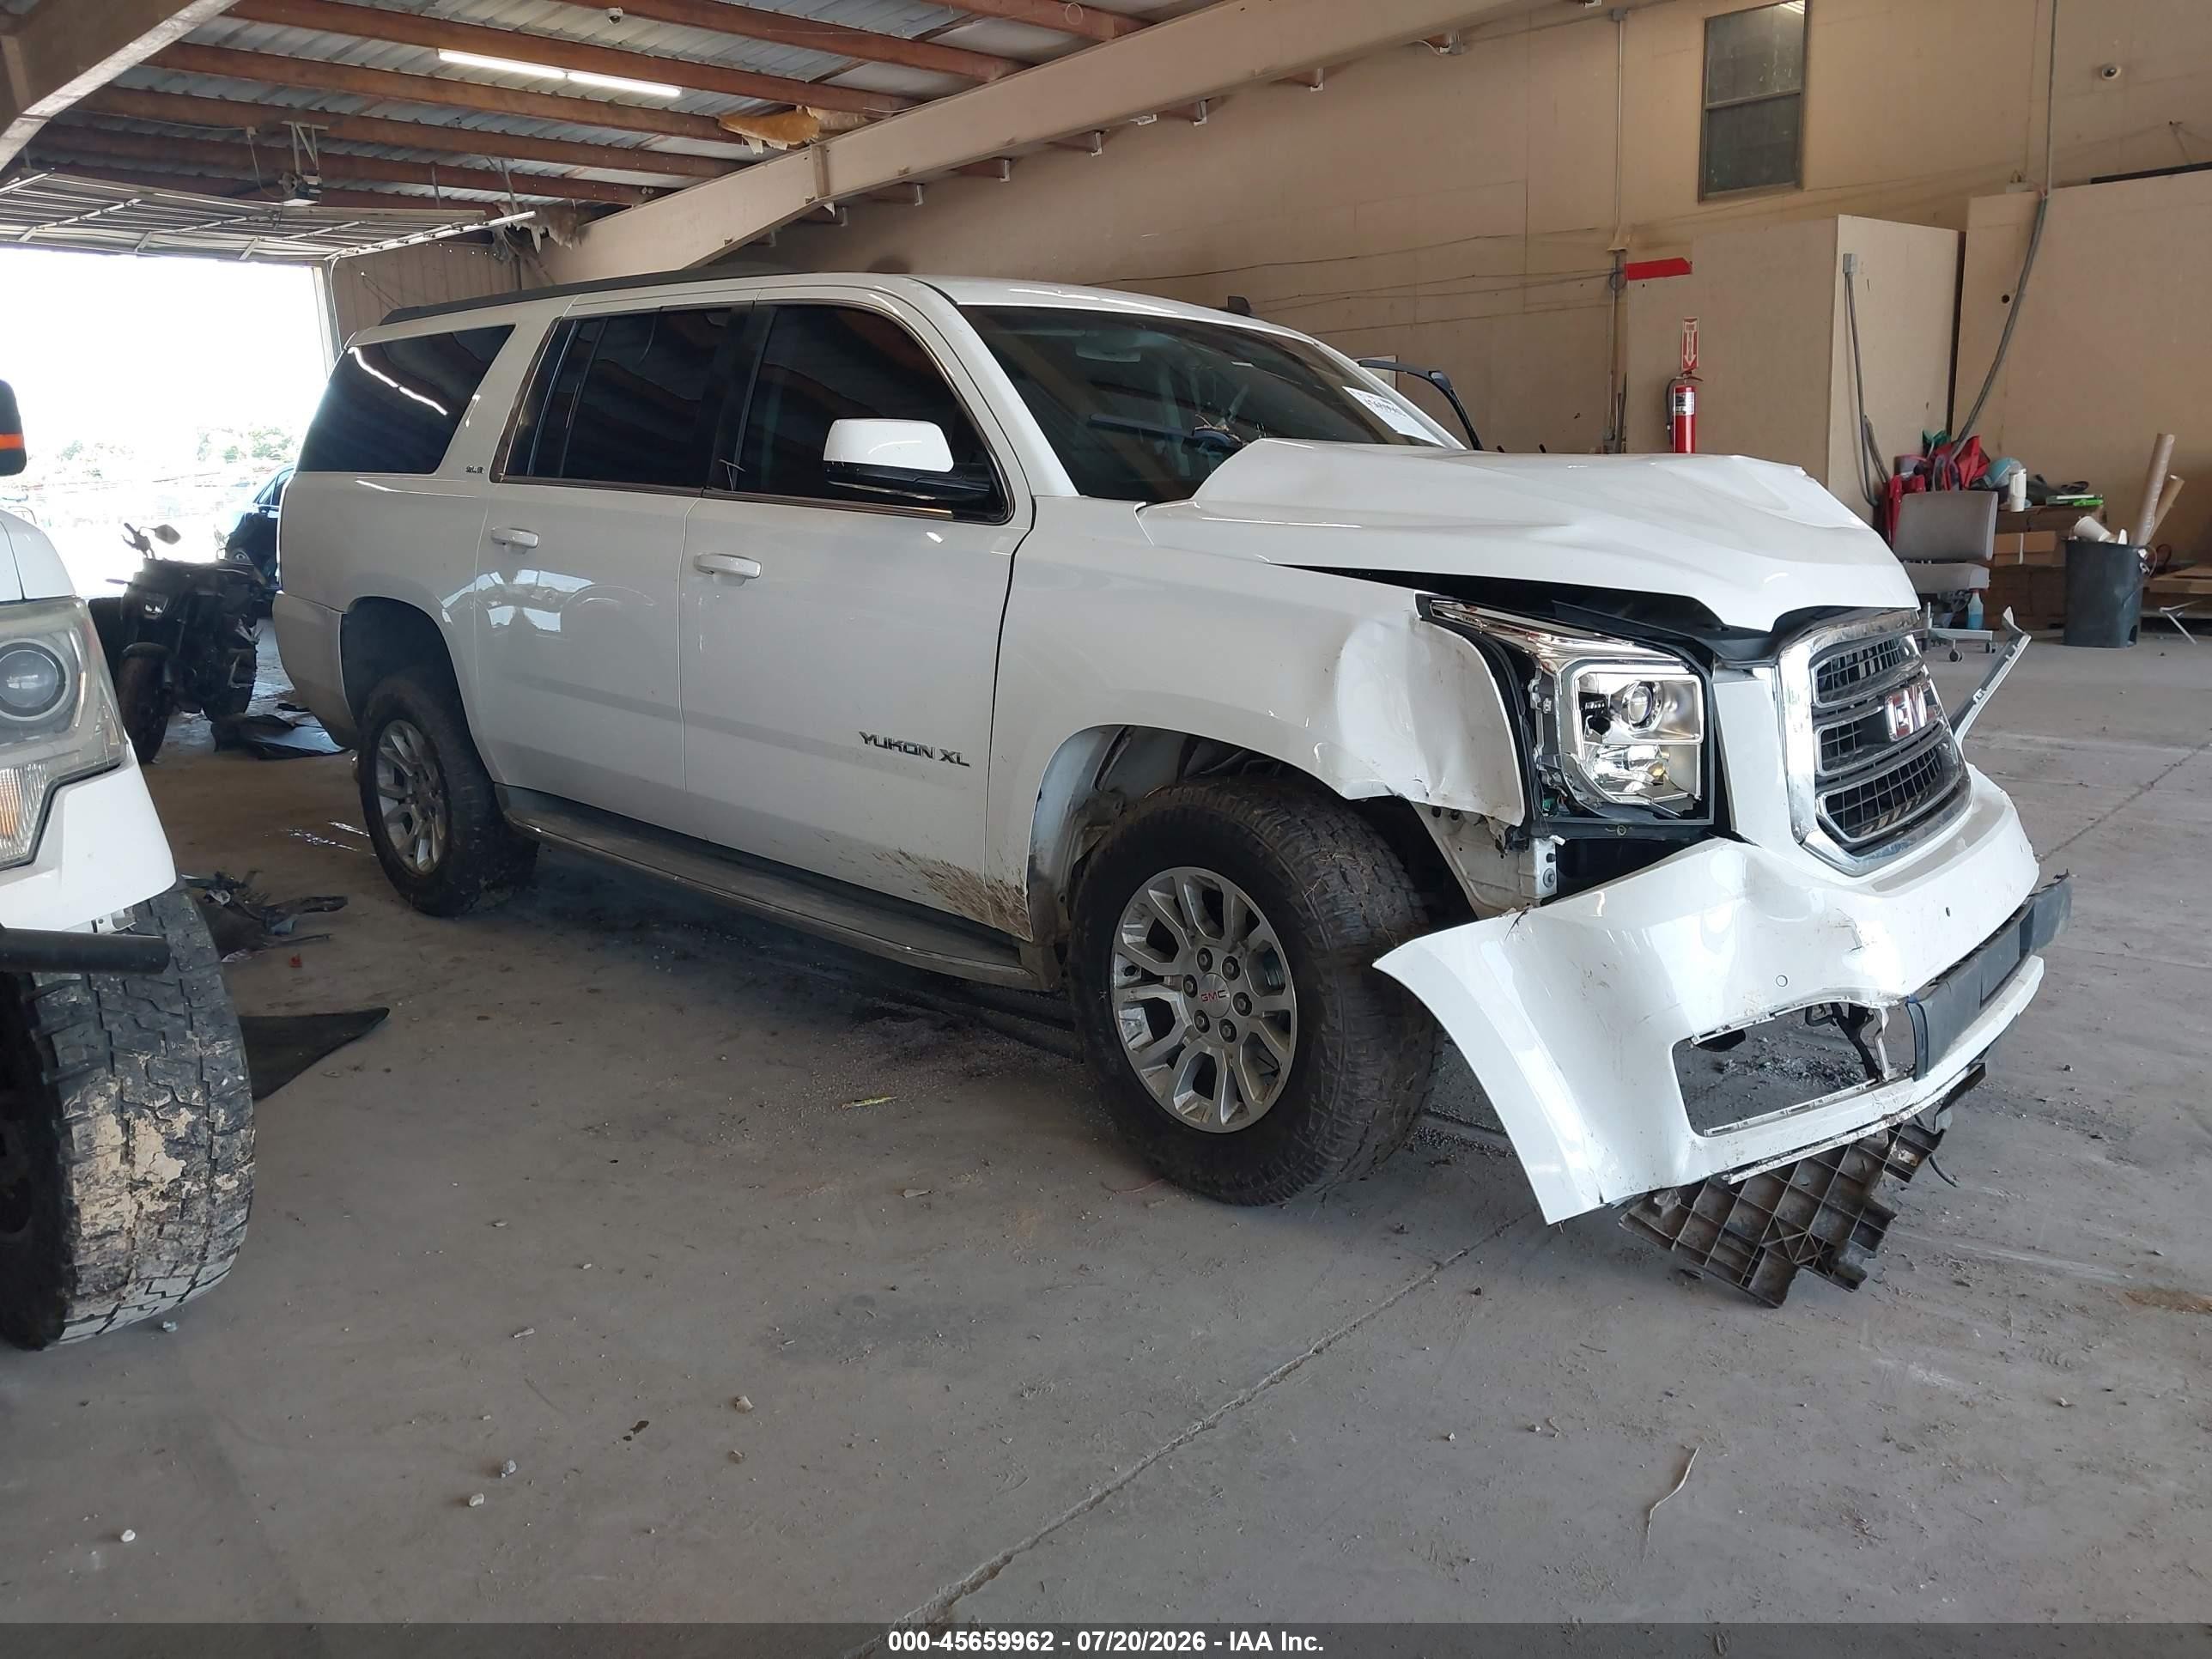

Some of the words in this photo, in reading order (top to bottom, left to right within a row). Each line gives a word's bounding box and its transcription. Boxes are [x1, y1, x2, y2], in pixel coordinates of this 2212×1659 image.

[859, 731, 935, 759] YUKON
[939, 748, 970, 767] XL
[1200, 989, 1227, 1002] GMC
